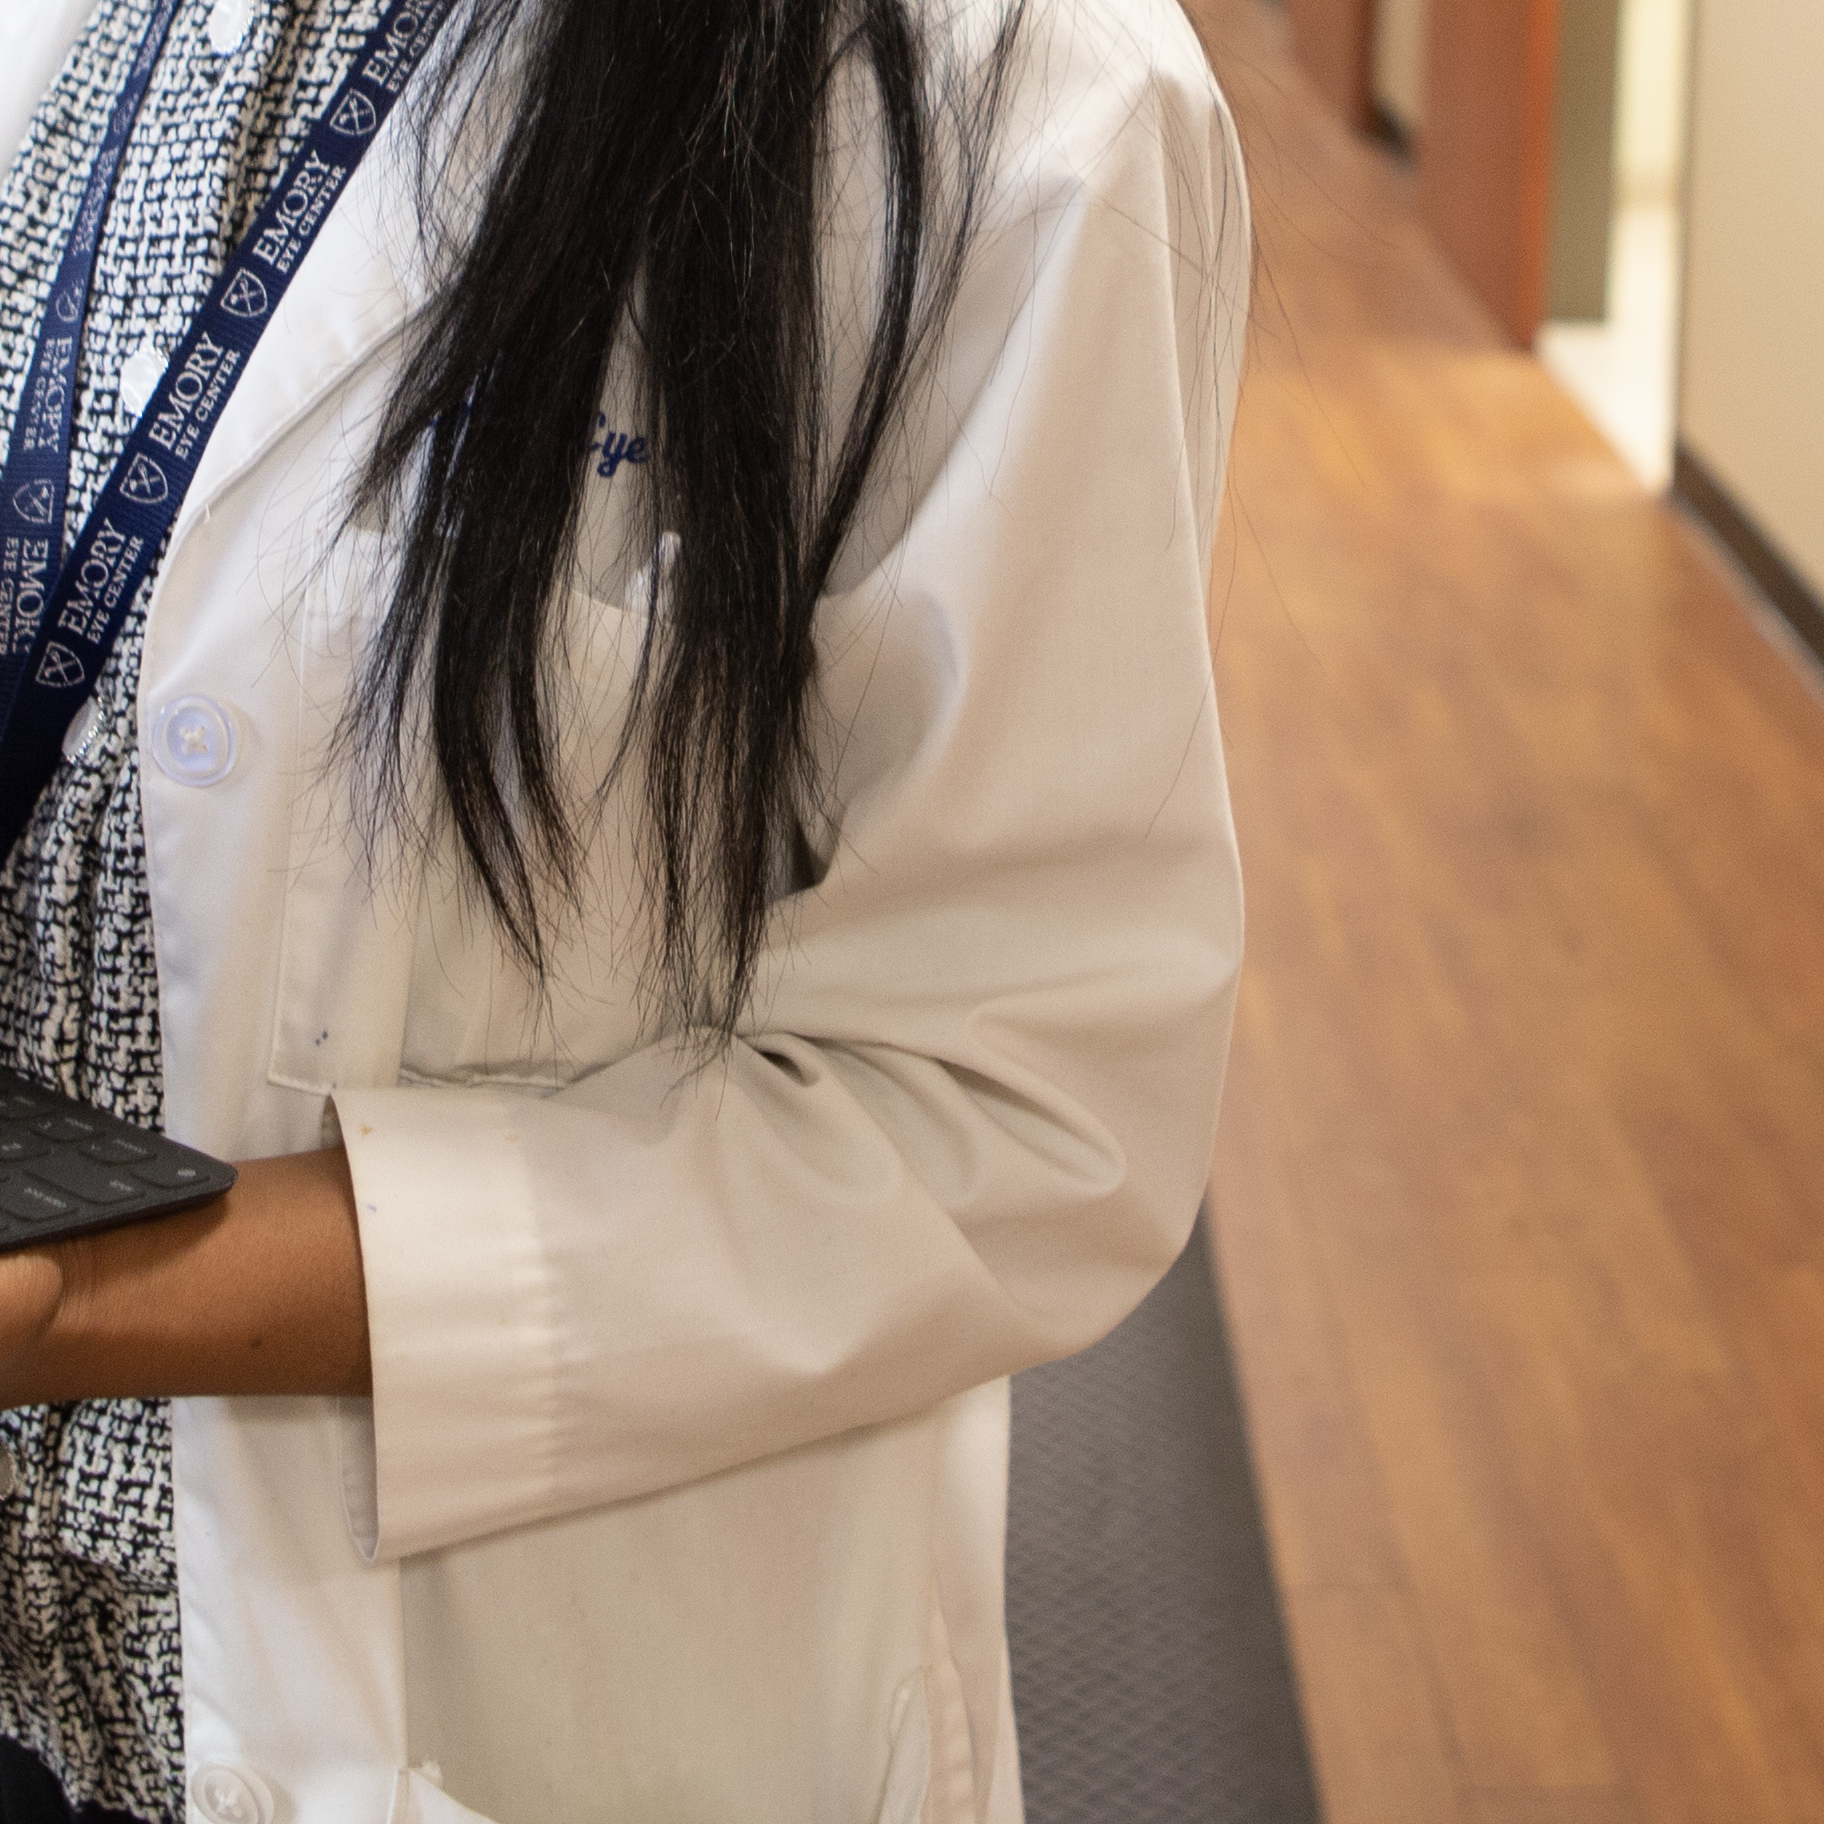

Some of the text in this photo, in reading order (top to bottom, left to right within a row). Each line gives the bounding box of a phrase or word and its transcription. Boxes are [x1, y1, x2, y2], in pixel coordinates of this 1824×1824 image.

[251, 149, 332, 266] EMORY
[276, 165, 347, 274] EYE CENTER
[38, 335, 74, 454] EMORY
[148, 330, 226, 451] EMORY
[174, 348, 243, 462] EYE CENTER
[2, 536, 20, 571] EYE
[57, 516, 128, 637] EMORY
[86, 535, 146, 645] EYE CENTER
